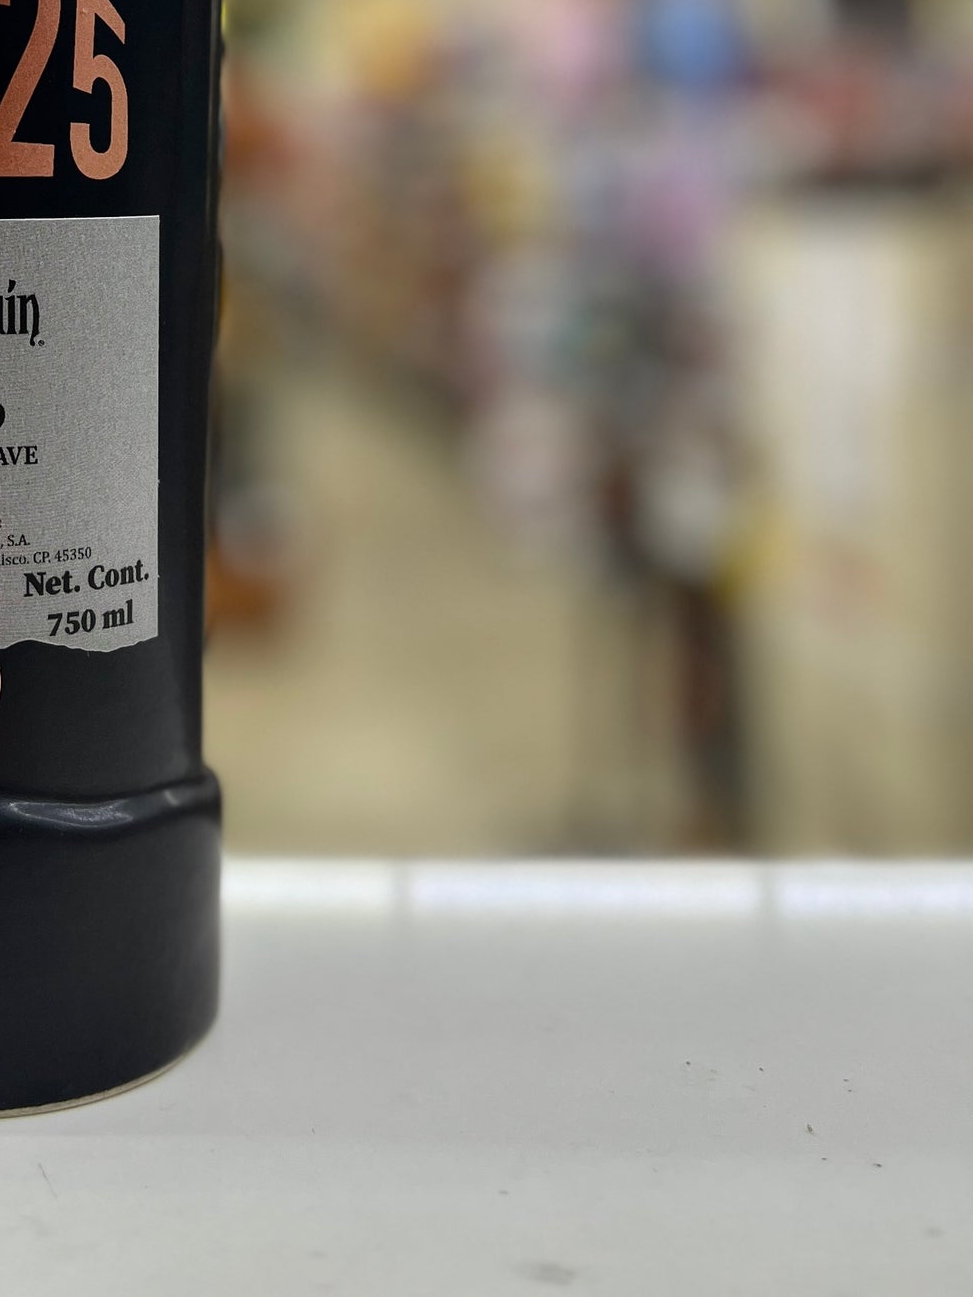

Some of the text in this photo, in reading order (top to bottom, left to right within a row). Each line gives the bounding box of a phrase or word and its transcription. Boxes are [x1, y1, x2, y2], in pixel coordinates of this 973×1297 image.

[7, 534, 31, 547] S.A.
[54, 546, 92, 562] 45350
[23, 559, 149, 597] Net. Cont.
[47, 599, 134, 637] 750 ml
